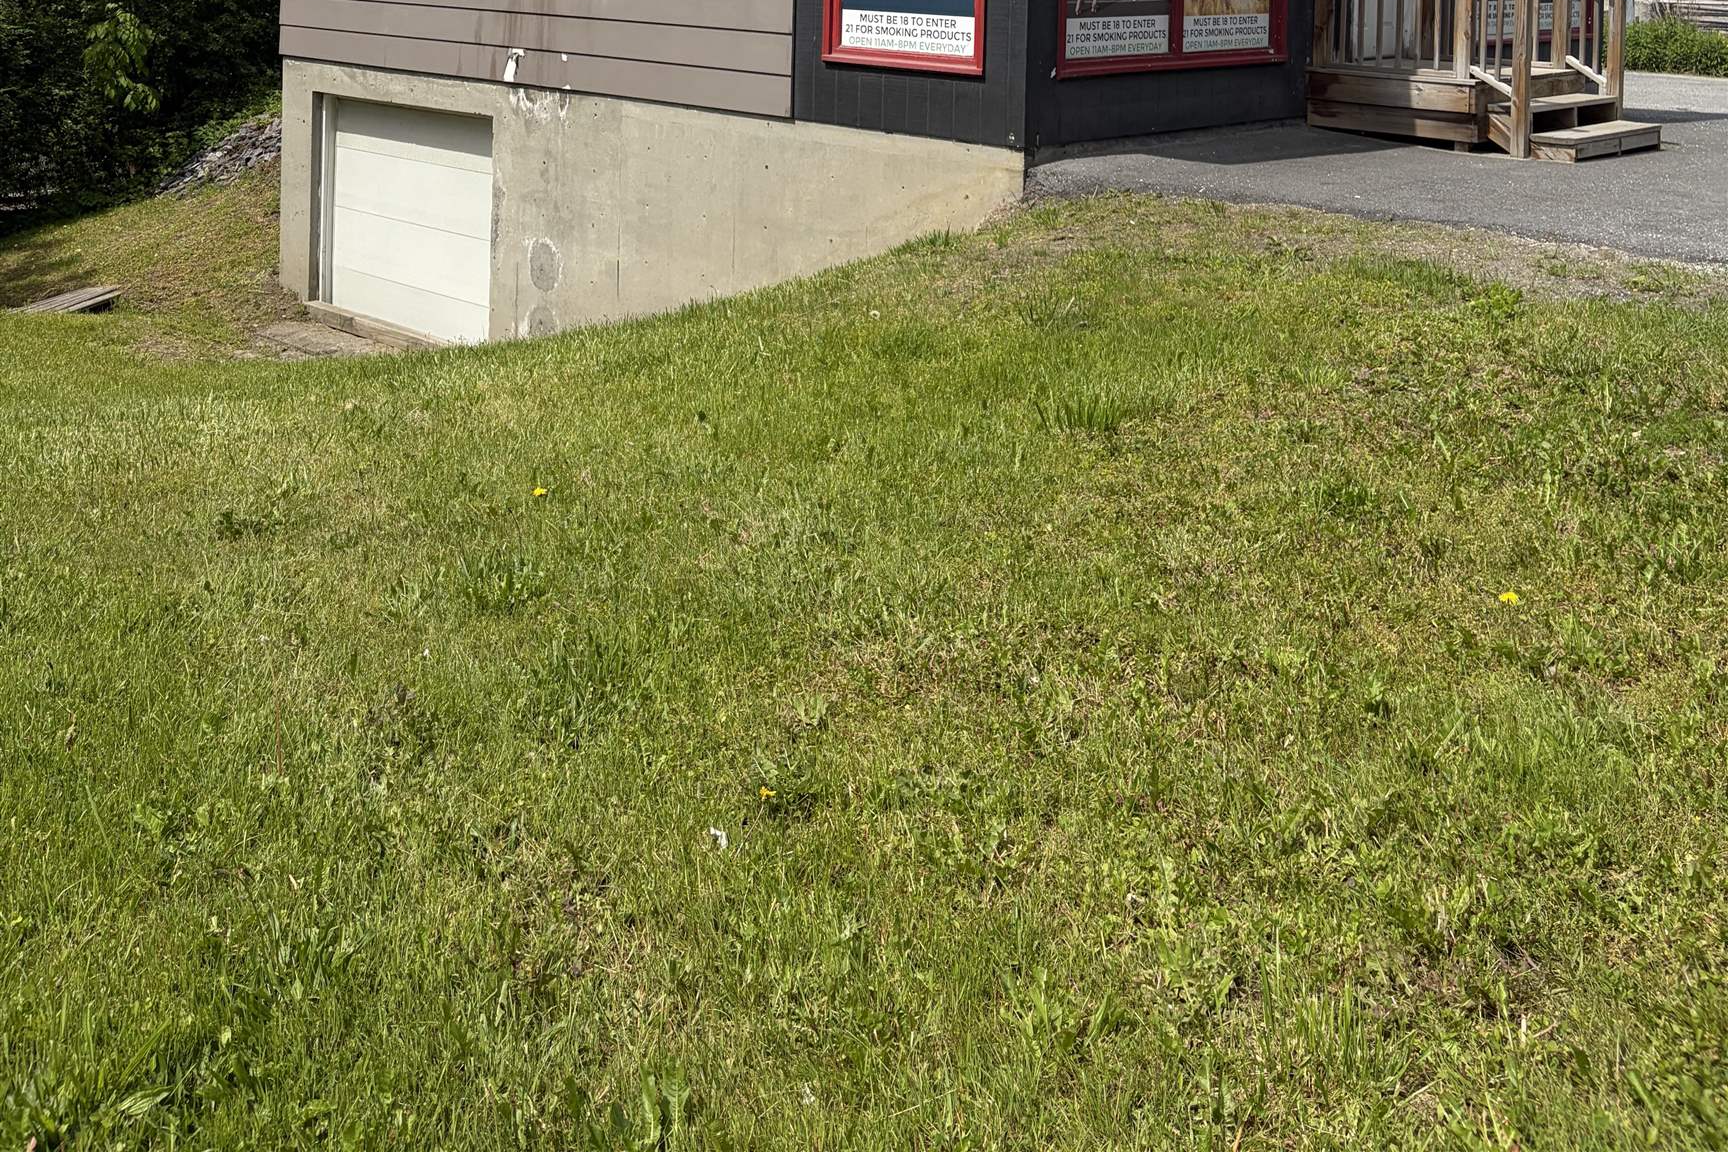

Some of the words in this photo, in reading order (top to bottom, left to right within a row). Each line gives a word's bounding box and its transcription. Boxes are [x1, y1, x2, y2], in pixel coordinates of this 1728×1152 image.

[860, 14, 884, 24] MUST
[886, 15, 898, 25] BE
[900, 16, 909, 26] 18
[911, 17, 923, 27] TO
[926, 18, 956, 28] ENTER
[1080, 21, 1100, 31] MUST
[1102, 21, 1111, 30] BE
[1112, 20, 1120, 29] 18
[1122, 20, 1131, 29] TO
[1133, 19, 1156, 28] ENTER
[1193, 17, 1211, 27] MUST
[1213, 17, 1220, 26] BE
[1222, 17, 1228, 25] 18
[1229, 16, 1237, 25] TO
[1238, 16, 1259, 25] ENTER
[845, 24, 853, 33] 21
[856, 25, 873, 35] FOR
[875, 26, 918, 38] SMOKING
[920, 29, 972, 42] PRODUCTS
[1067, 34, 1074, 44] 21
[1076, 33, 1091, 43] FOR
[1092, 31, 1127, 42] SMOKING
[1129, 30, 1167, 40] PRODUCTS
[1183, 29, 1189, 38] 21
[1190, 28, 1203, 38] FOR
[1205, 27, 1234, 37] SMOKING
[1235, 26, 1267, 36] PRODUCTS
[849, 36, 872, 46] OPEN
[874, 38, 917, 49] 11AM-8PM
[919, 41, 966, 53] EVERYDAY
[1069, 46, 1090, 56] OPEN
[1128, 41, 1162, 52] EVERYDAY
